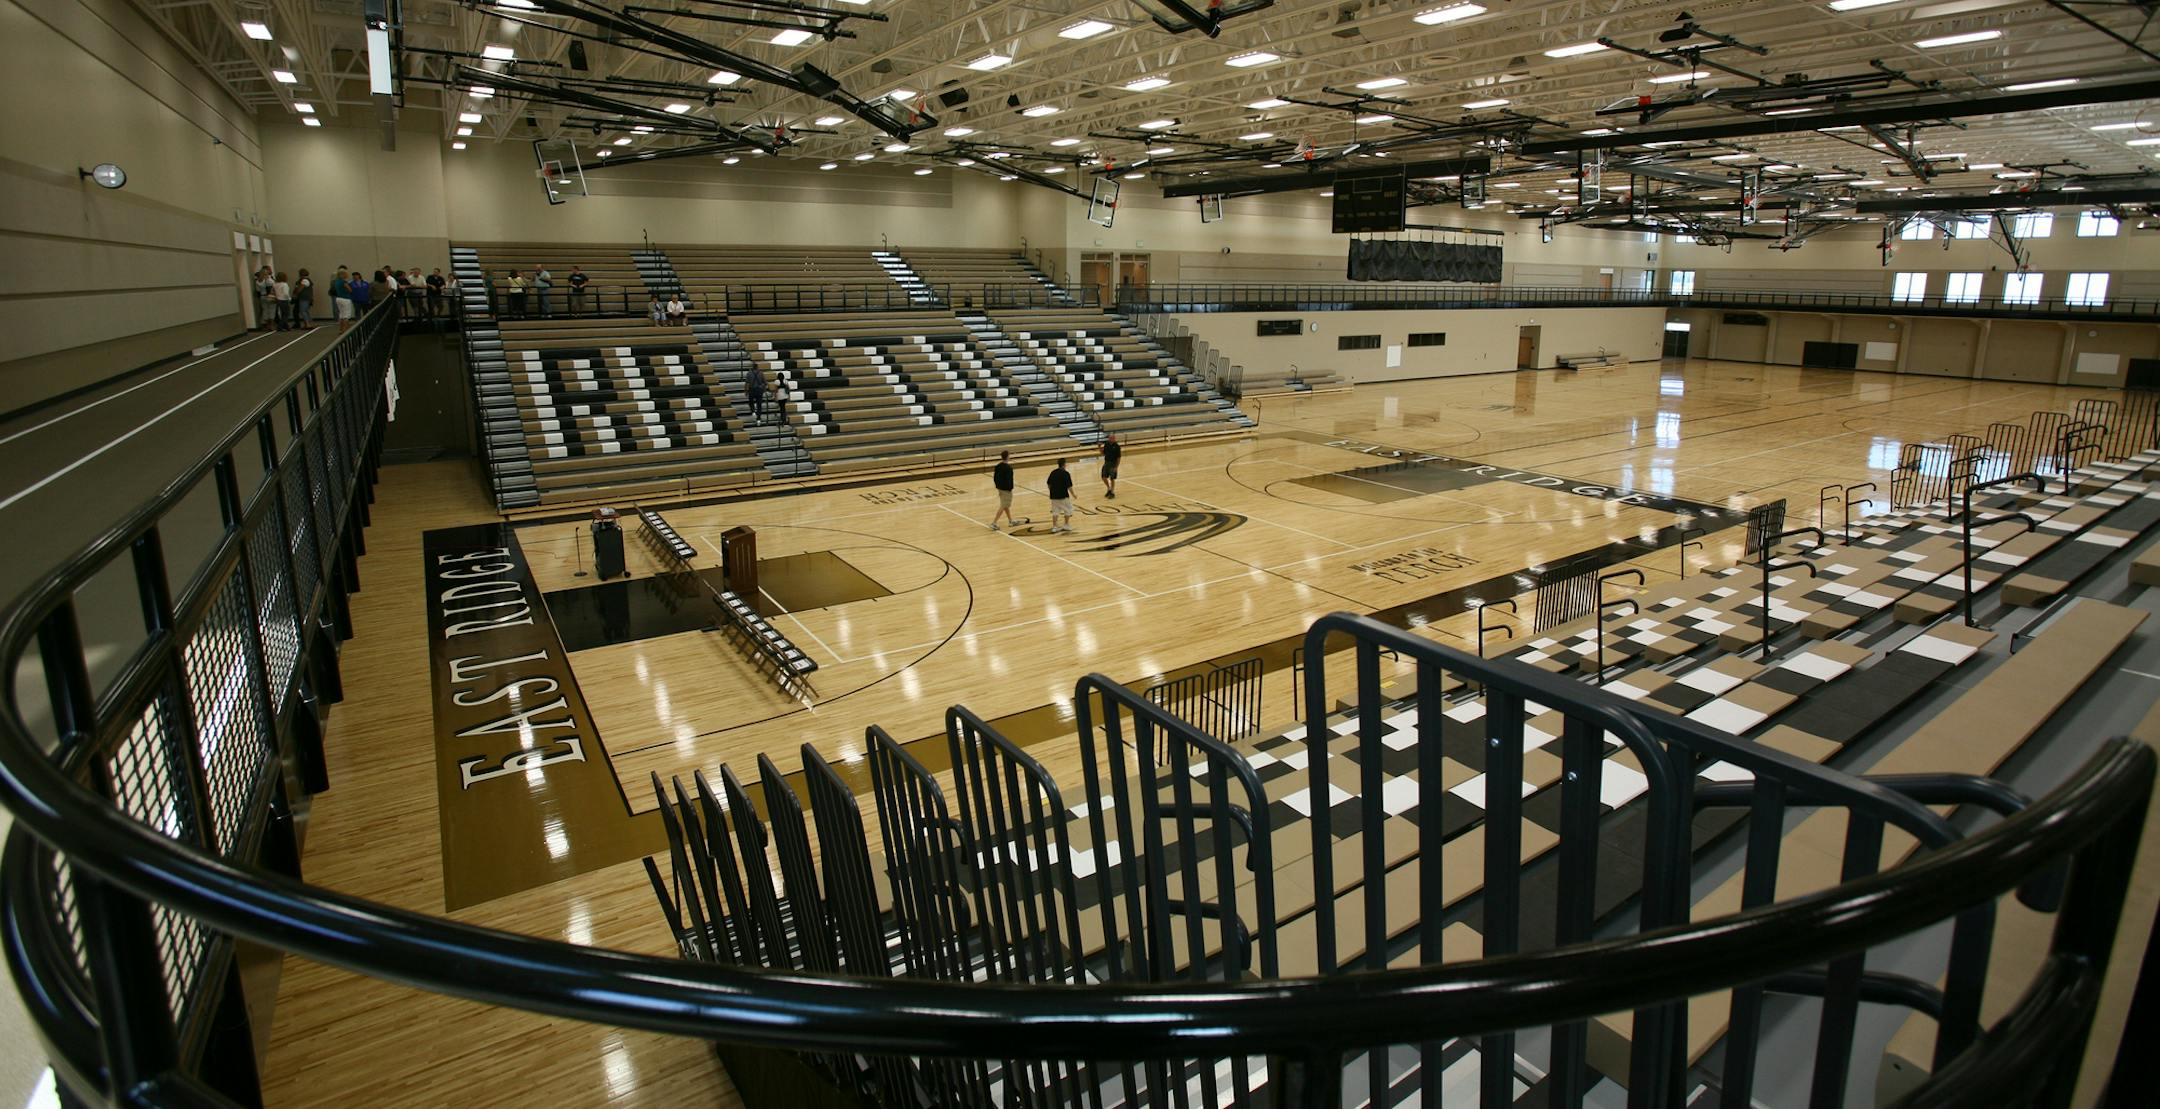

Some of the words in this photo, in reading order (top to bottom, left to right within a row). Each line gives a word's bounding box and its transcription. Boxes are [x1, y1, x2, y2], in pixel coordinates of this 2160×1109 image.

[1324, 439, 1451, 462] EAST
[1459, 464, 1654, 504] RIDGE
[437, 547, 535, 640] RIDGE
[1372, 552, 1481, 584] PERCH
[449, 649, 588, 791] EAST
